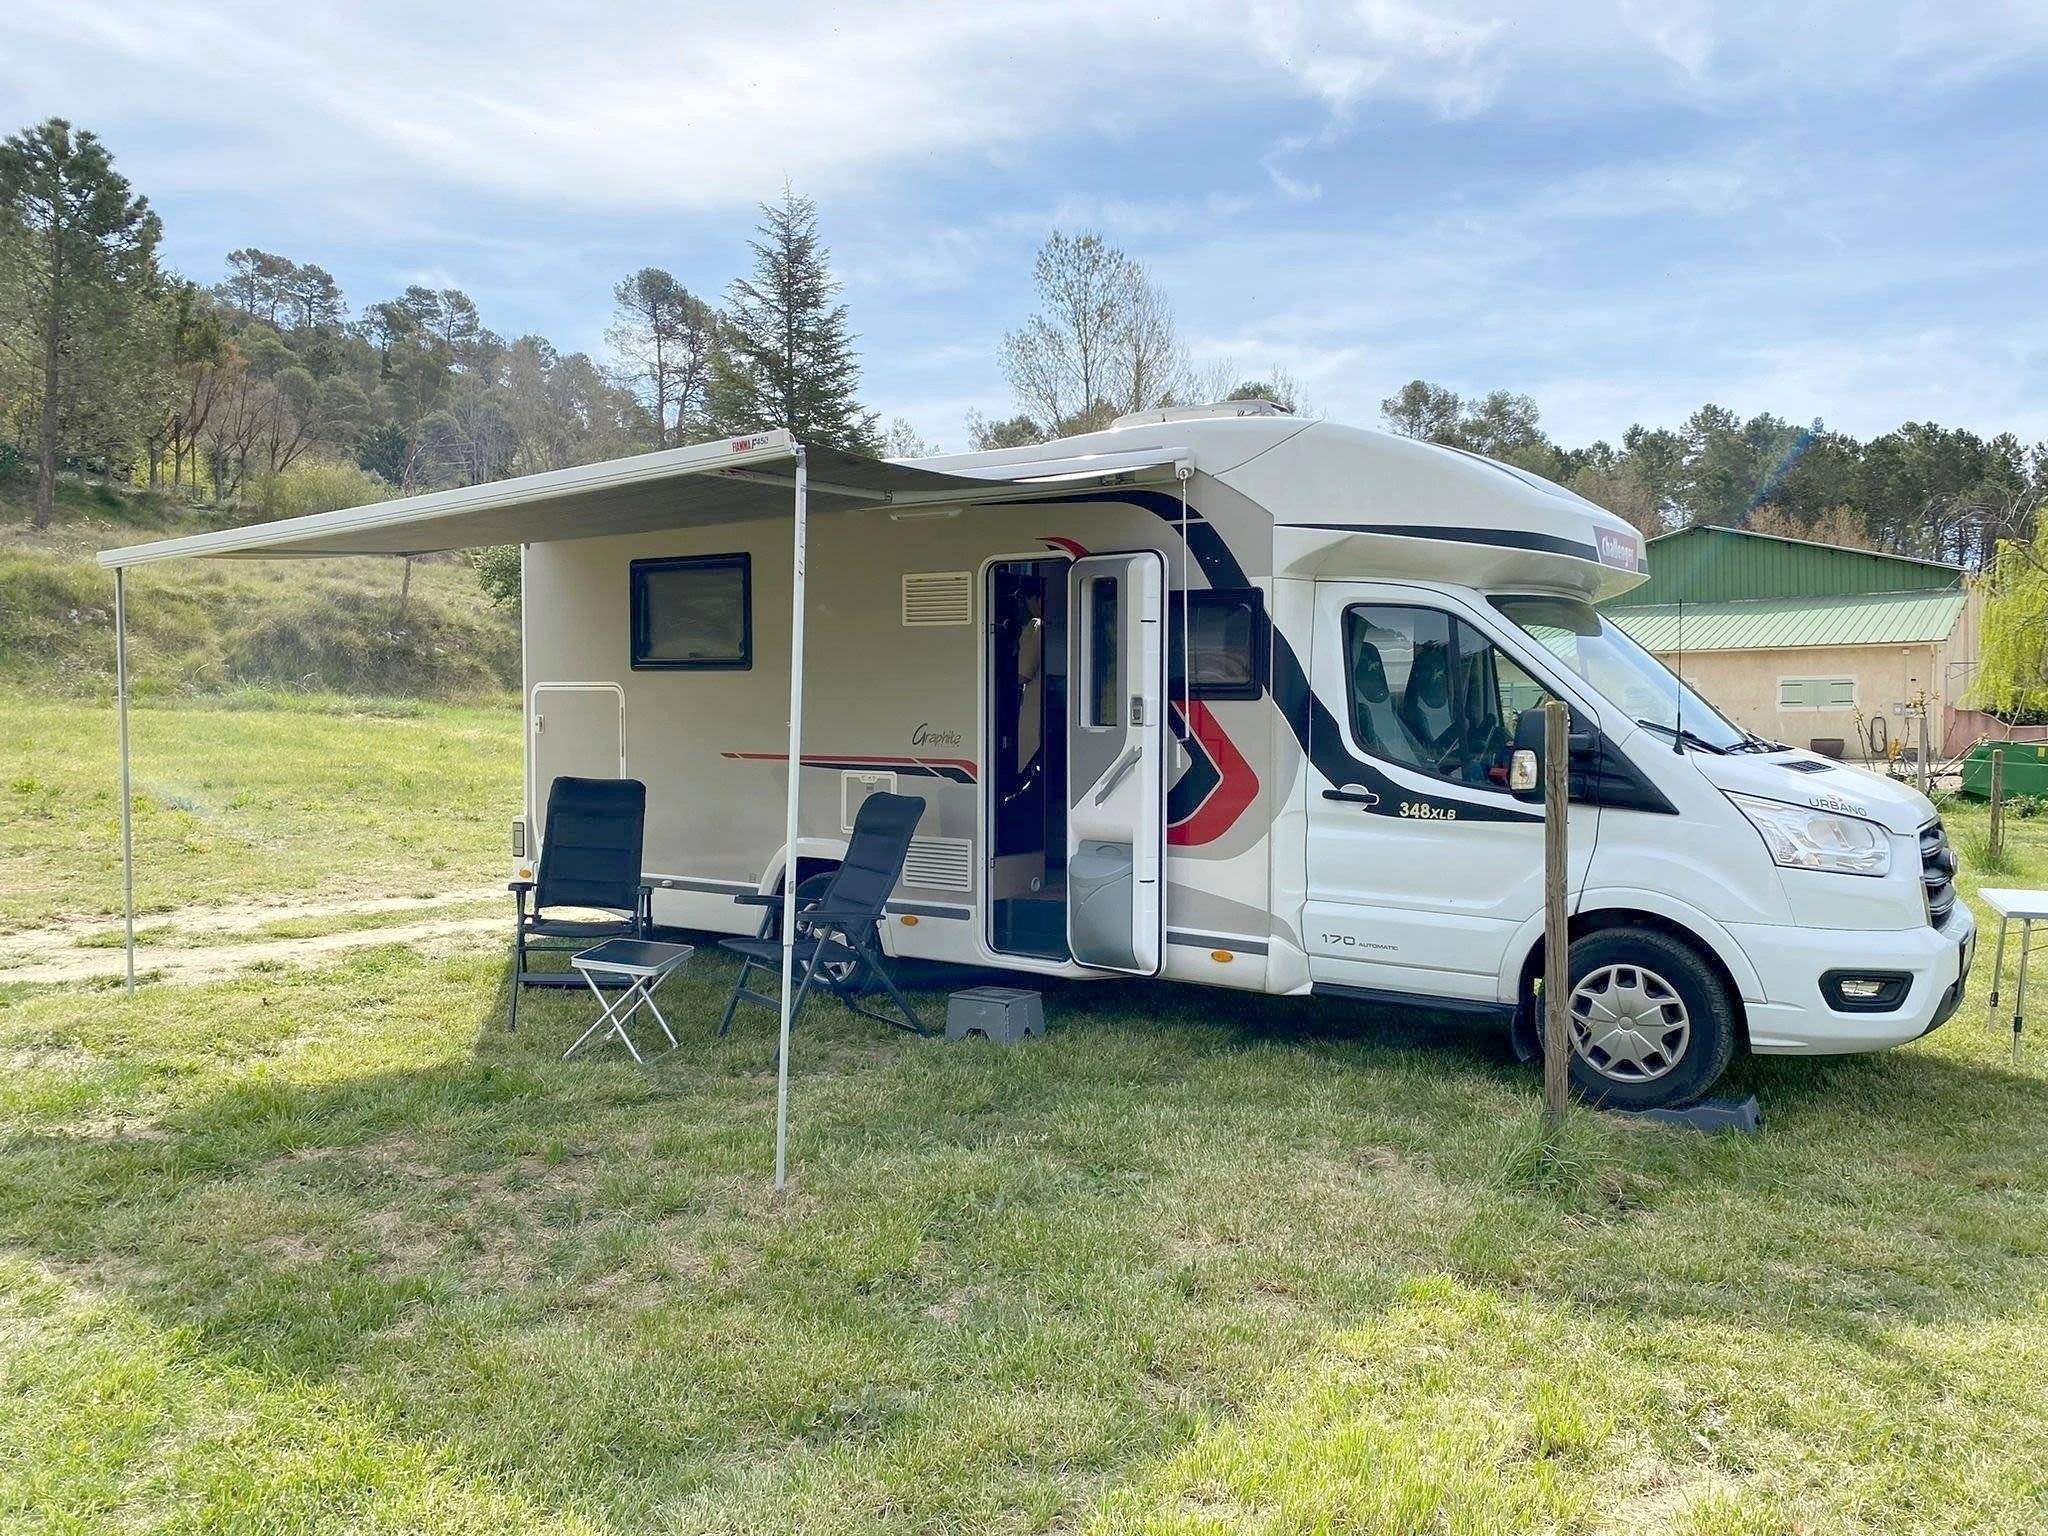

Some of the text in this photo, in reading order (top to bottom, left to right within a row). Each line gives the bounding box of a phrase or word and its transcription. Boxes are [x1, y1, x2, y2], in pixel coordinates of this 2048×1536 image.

[912, 722, 961, 747] Graphite
[1808, 798, 1867, 816] URBANO
[1321, 933, 1399, 951] 170 AUTOMATIC
